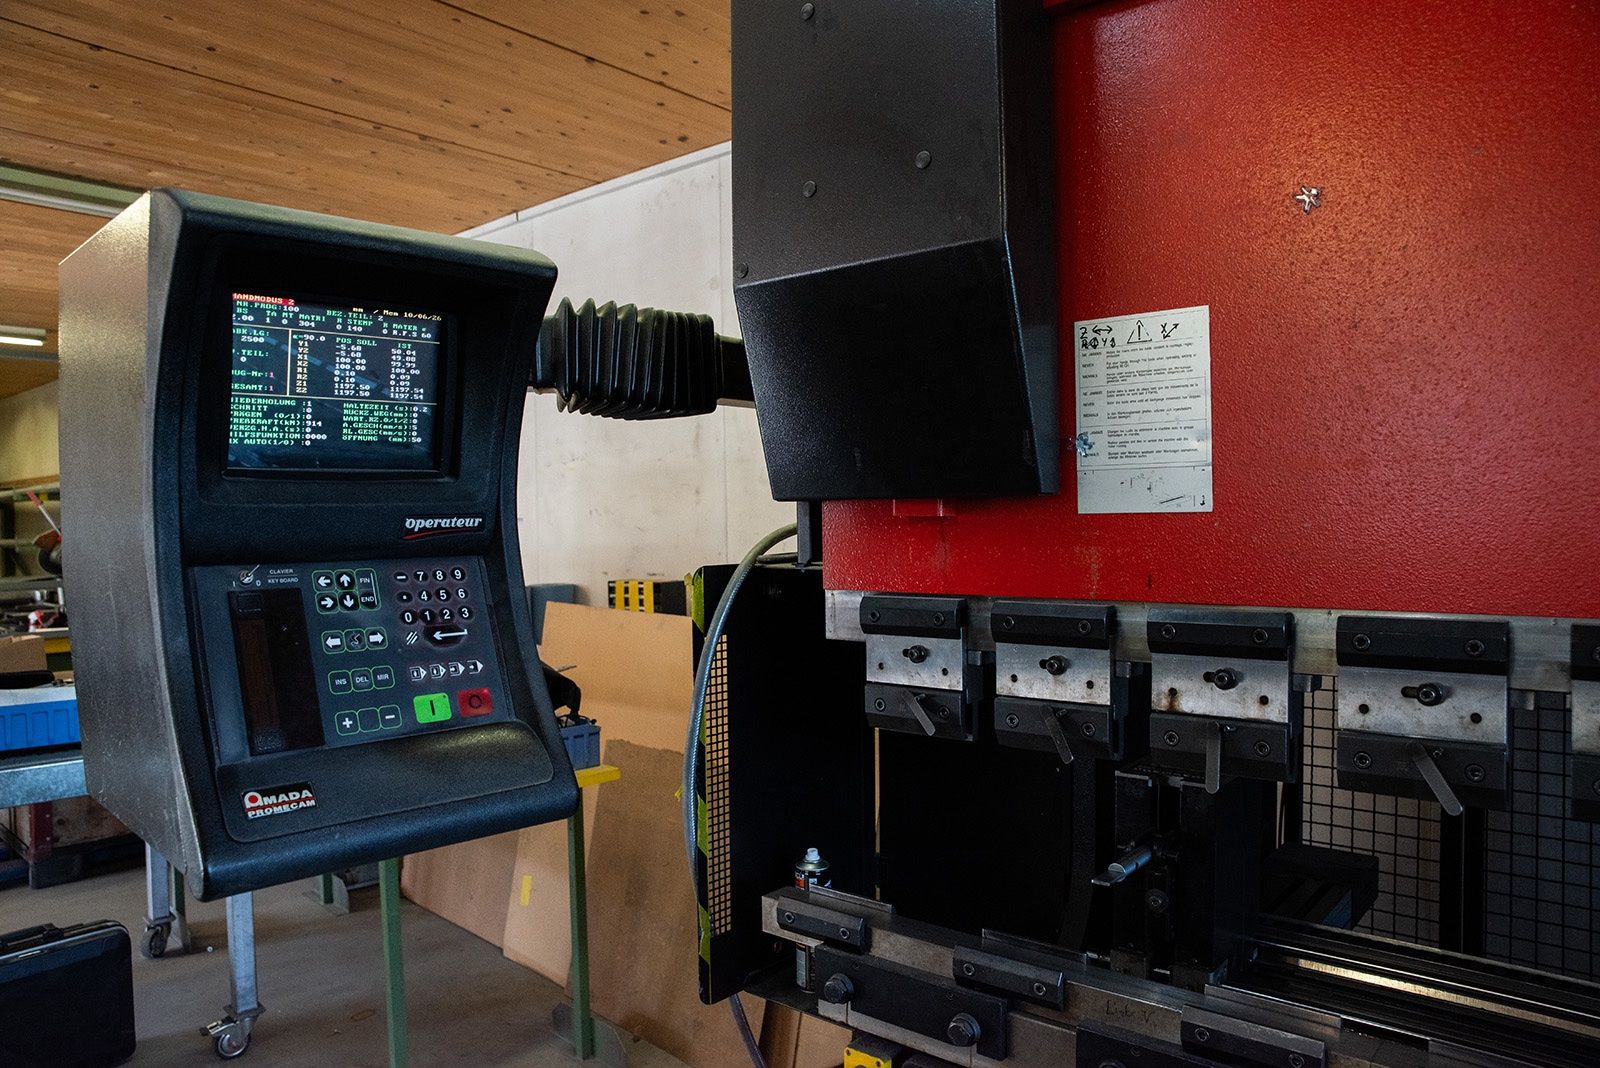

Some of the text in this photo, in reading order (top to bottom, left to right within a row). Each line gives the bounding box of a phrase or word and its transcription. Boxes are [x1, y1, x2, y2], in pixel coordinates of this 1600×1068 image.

[241, 335, 265, 343] 2500
[356, 339, 377, 347] SOLL
[405, 517, 482, 531] operateur
[417, 569, 461, 581] 7 8 9
[421, 588, 465, 601] 4 5 6
[404, 608, 469, 623] 0 1 2 3
[244, 789, 313, 808] AMADA
[248, 799, 316, 819] PROMECAM
